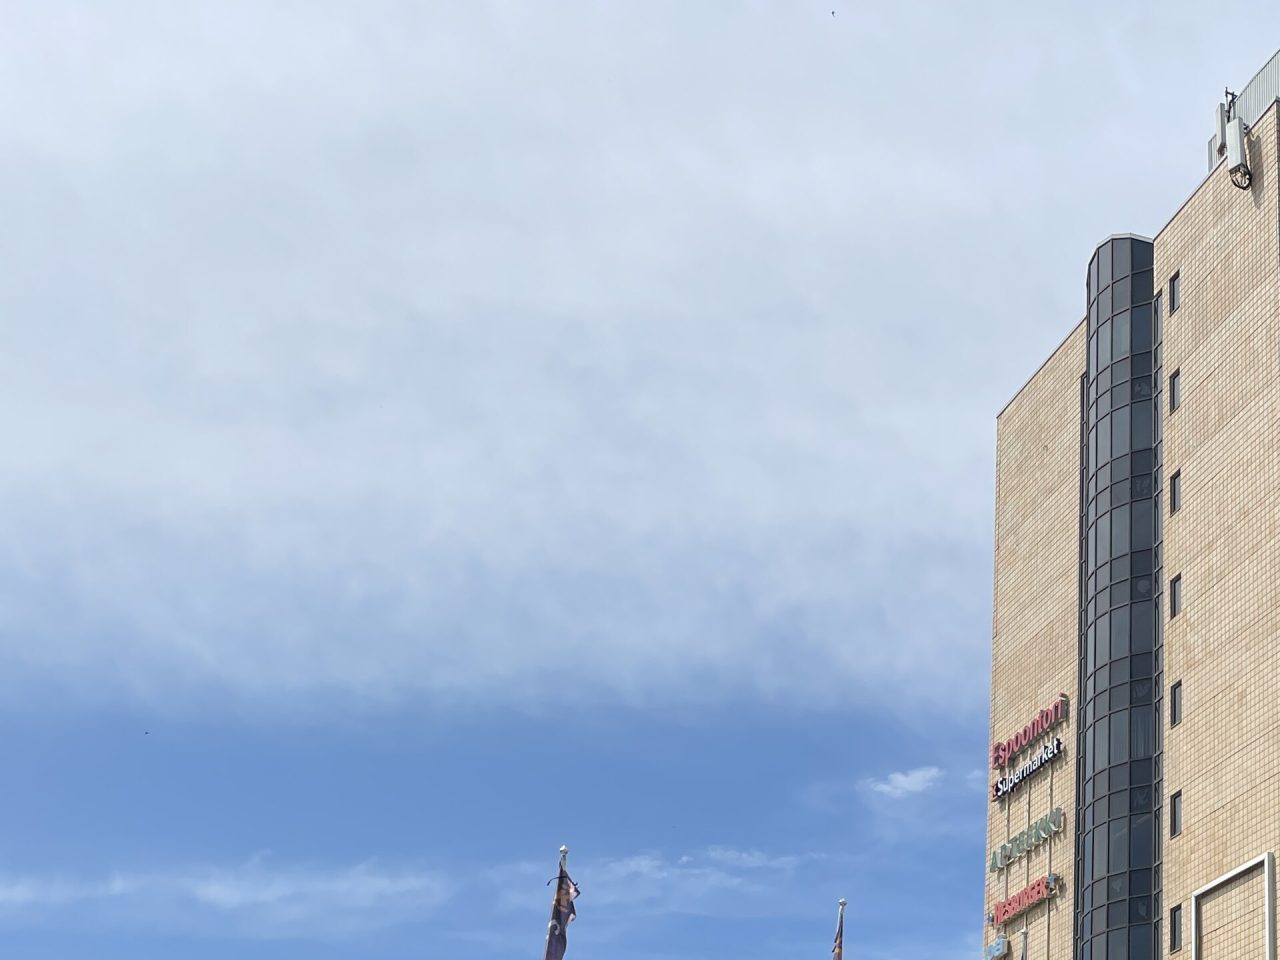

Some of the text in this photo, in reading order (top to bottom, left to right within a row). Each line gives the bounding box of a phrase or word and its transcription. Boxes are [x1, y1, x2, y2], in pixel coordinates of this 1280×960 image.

[990, 693, 1069, 770] Espoontori
[996, 737, 1062, 798] Supermarket
[993, 875, 1048, 925] HESBURGER
